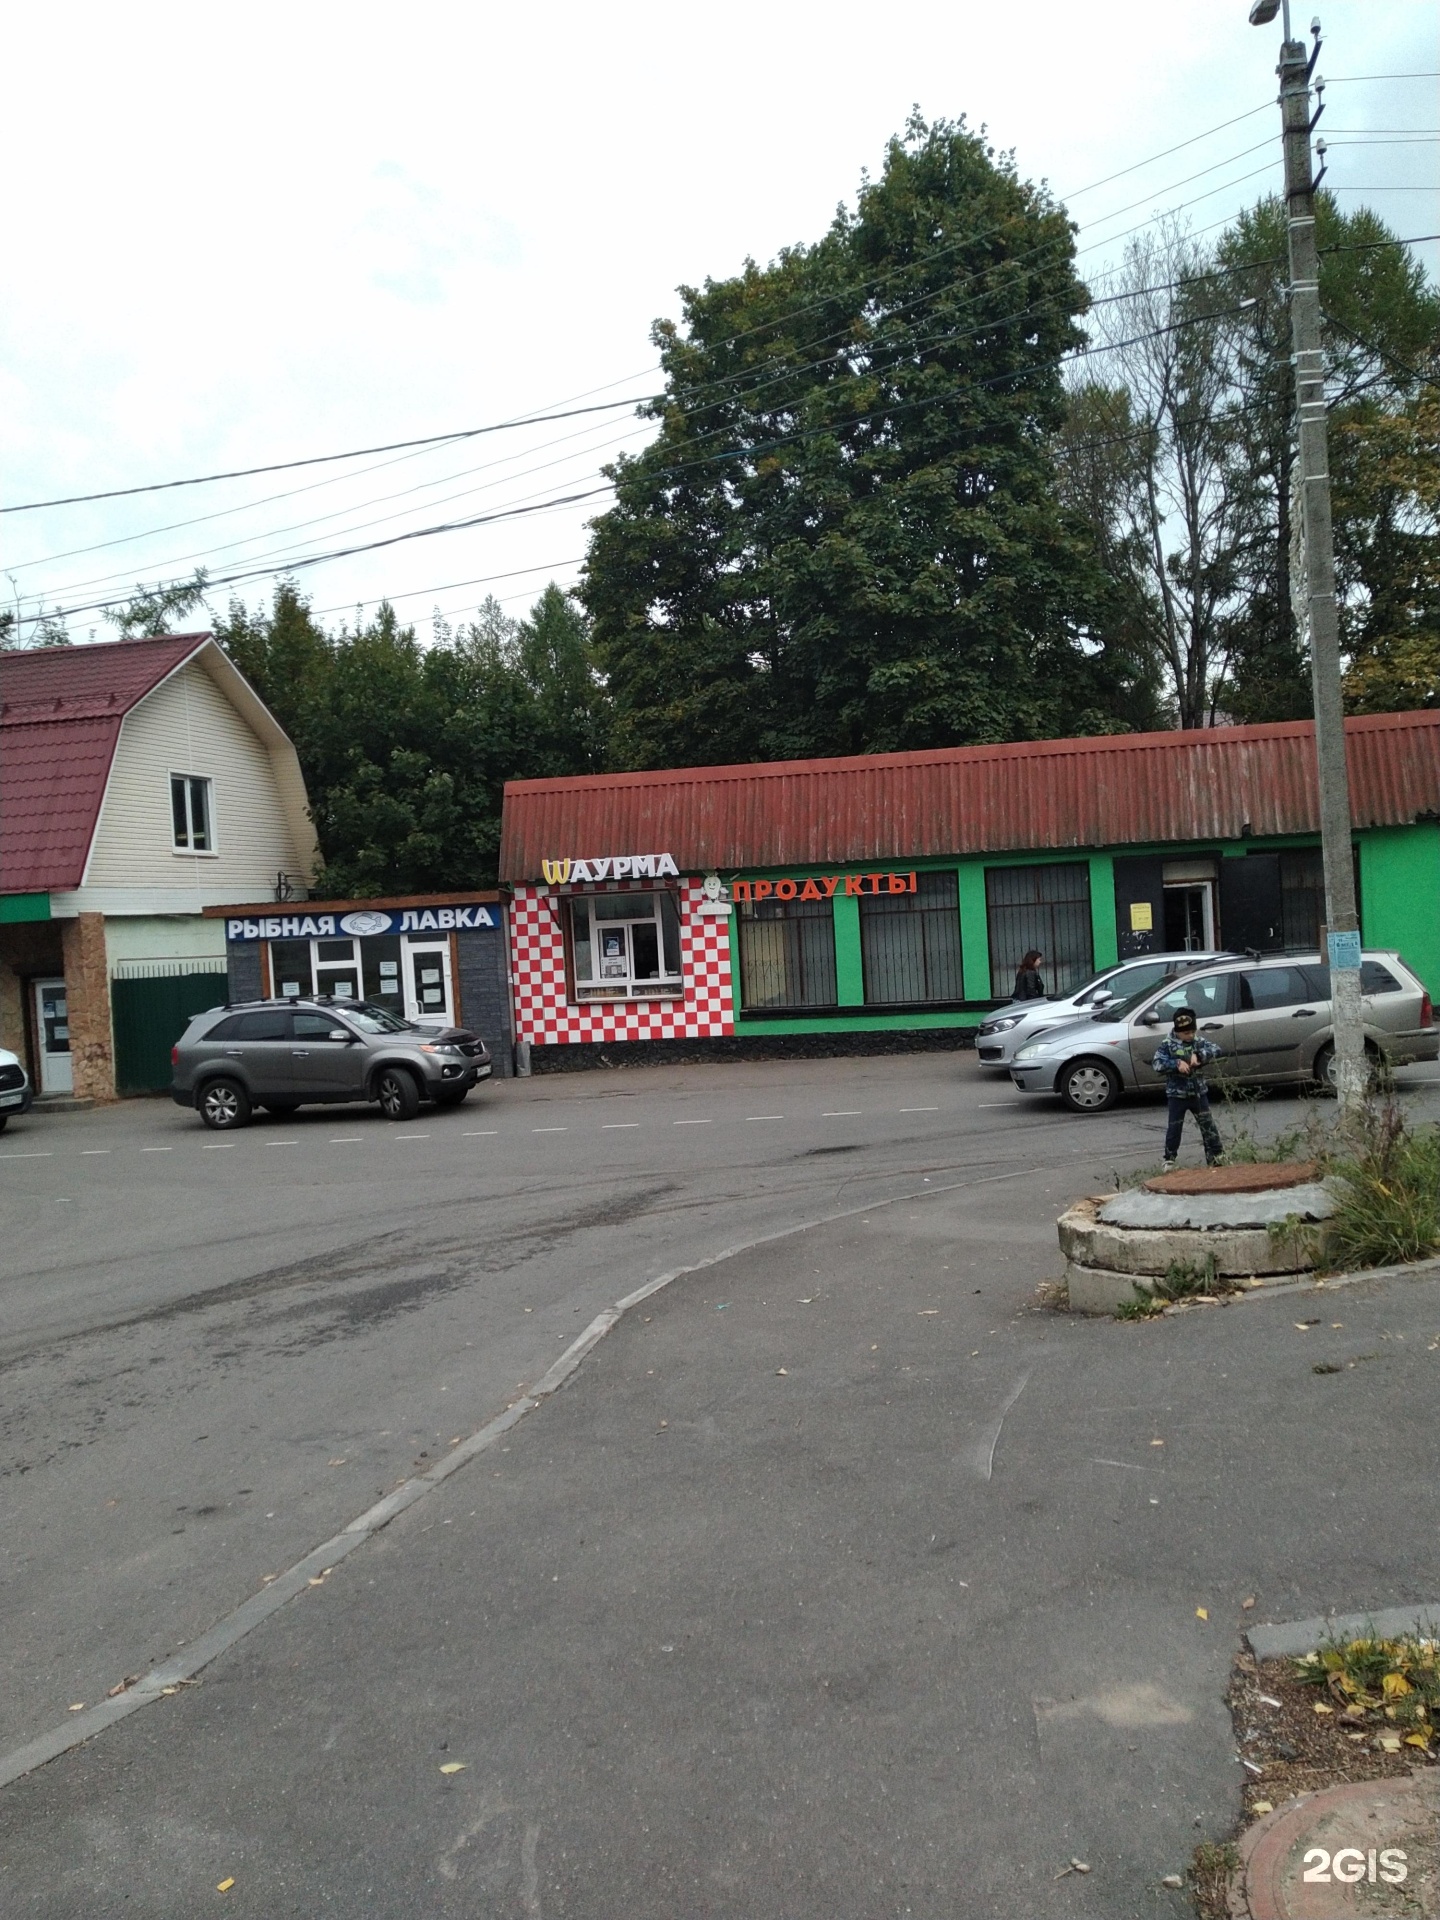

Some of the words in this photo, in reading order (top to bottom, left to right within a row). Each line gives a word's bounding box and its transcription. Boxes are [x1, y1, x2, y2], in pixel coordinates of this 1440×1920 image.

[733, 872, 917, 902] ПРОДУКТЫ
[228, 916, 336, 939] РЫБНАЯ
[400, 907, 494, 931] ЛАВКА
